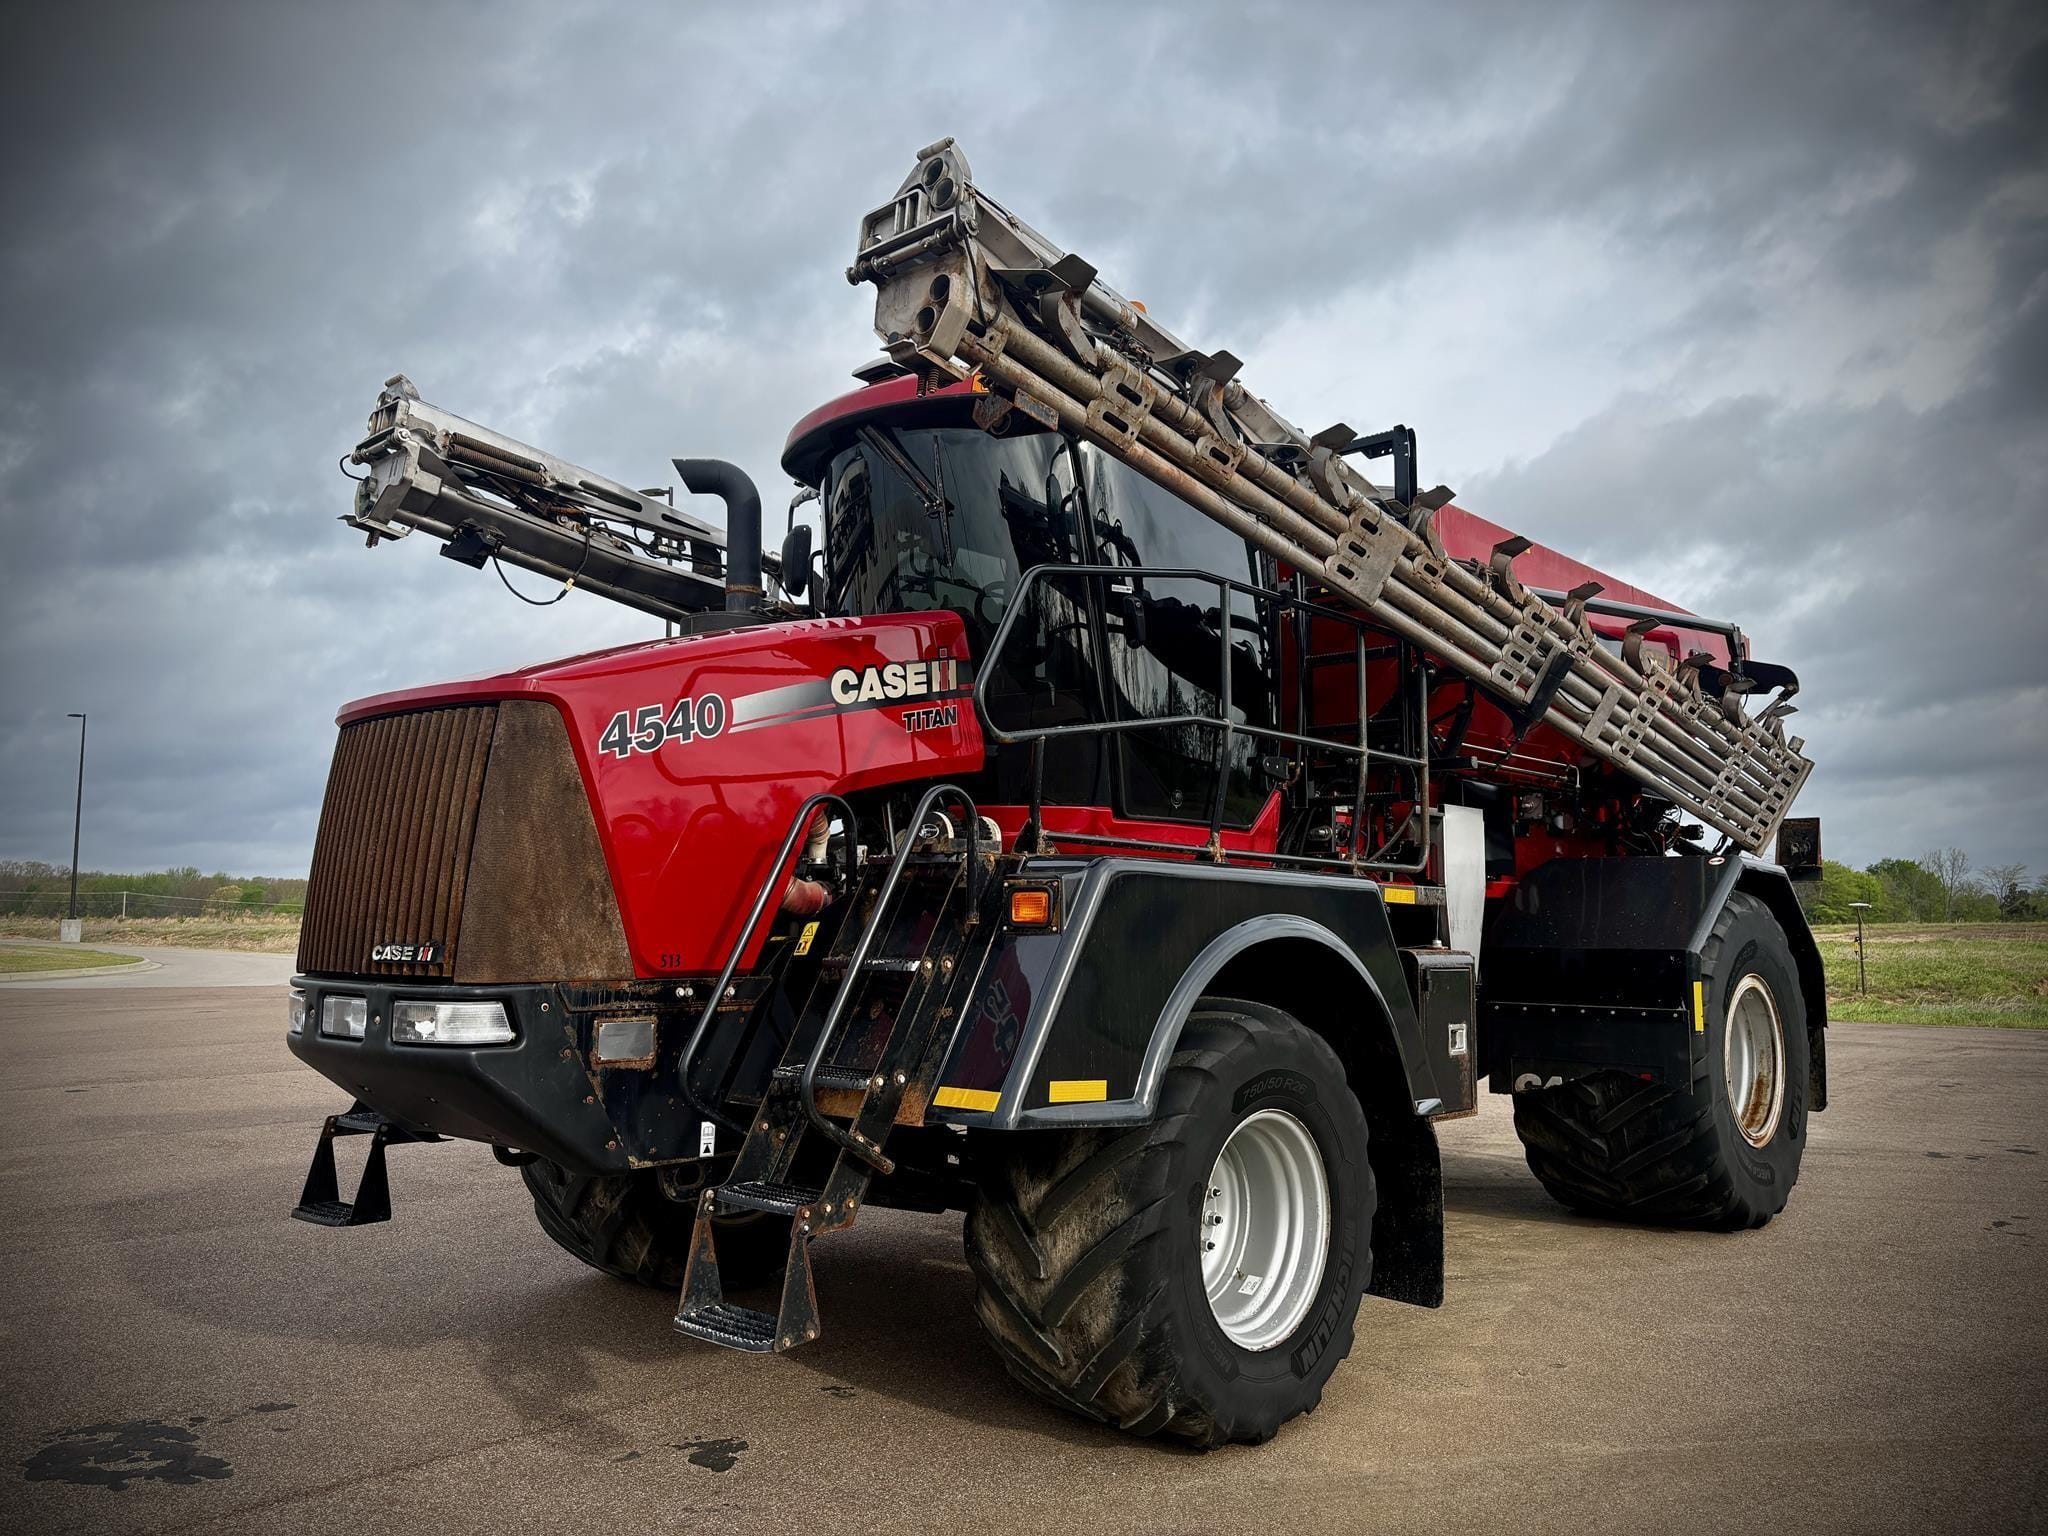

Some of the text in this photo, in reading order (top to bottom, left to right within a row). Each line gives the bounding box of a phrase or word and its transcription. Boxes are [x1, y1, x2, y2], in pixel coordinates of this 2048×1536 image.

[829, 660, 929, 706] CASE
[599, 692, 726, 759] 4540
[902, 705, 958, 733] TITAN
[371, 944, 415, 961] CASE
[660, 948, 681, 968] 513
[1300, 1217, 1356, 1375] MICHELIN
